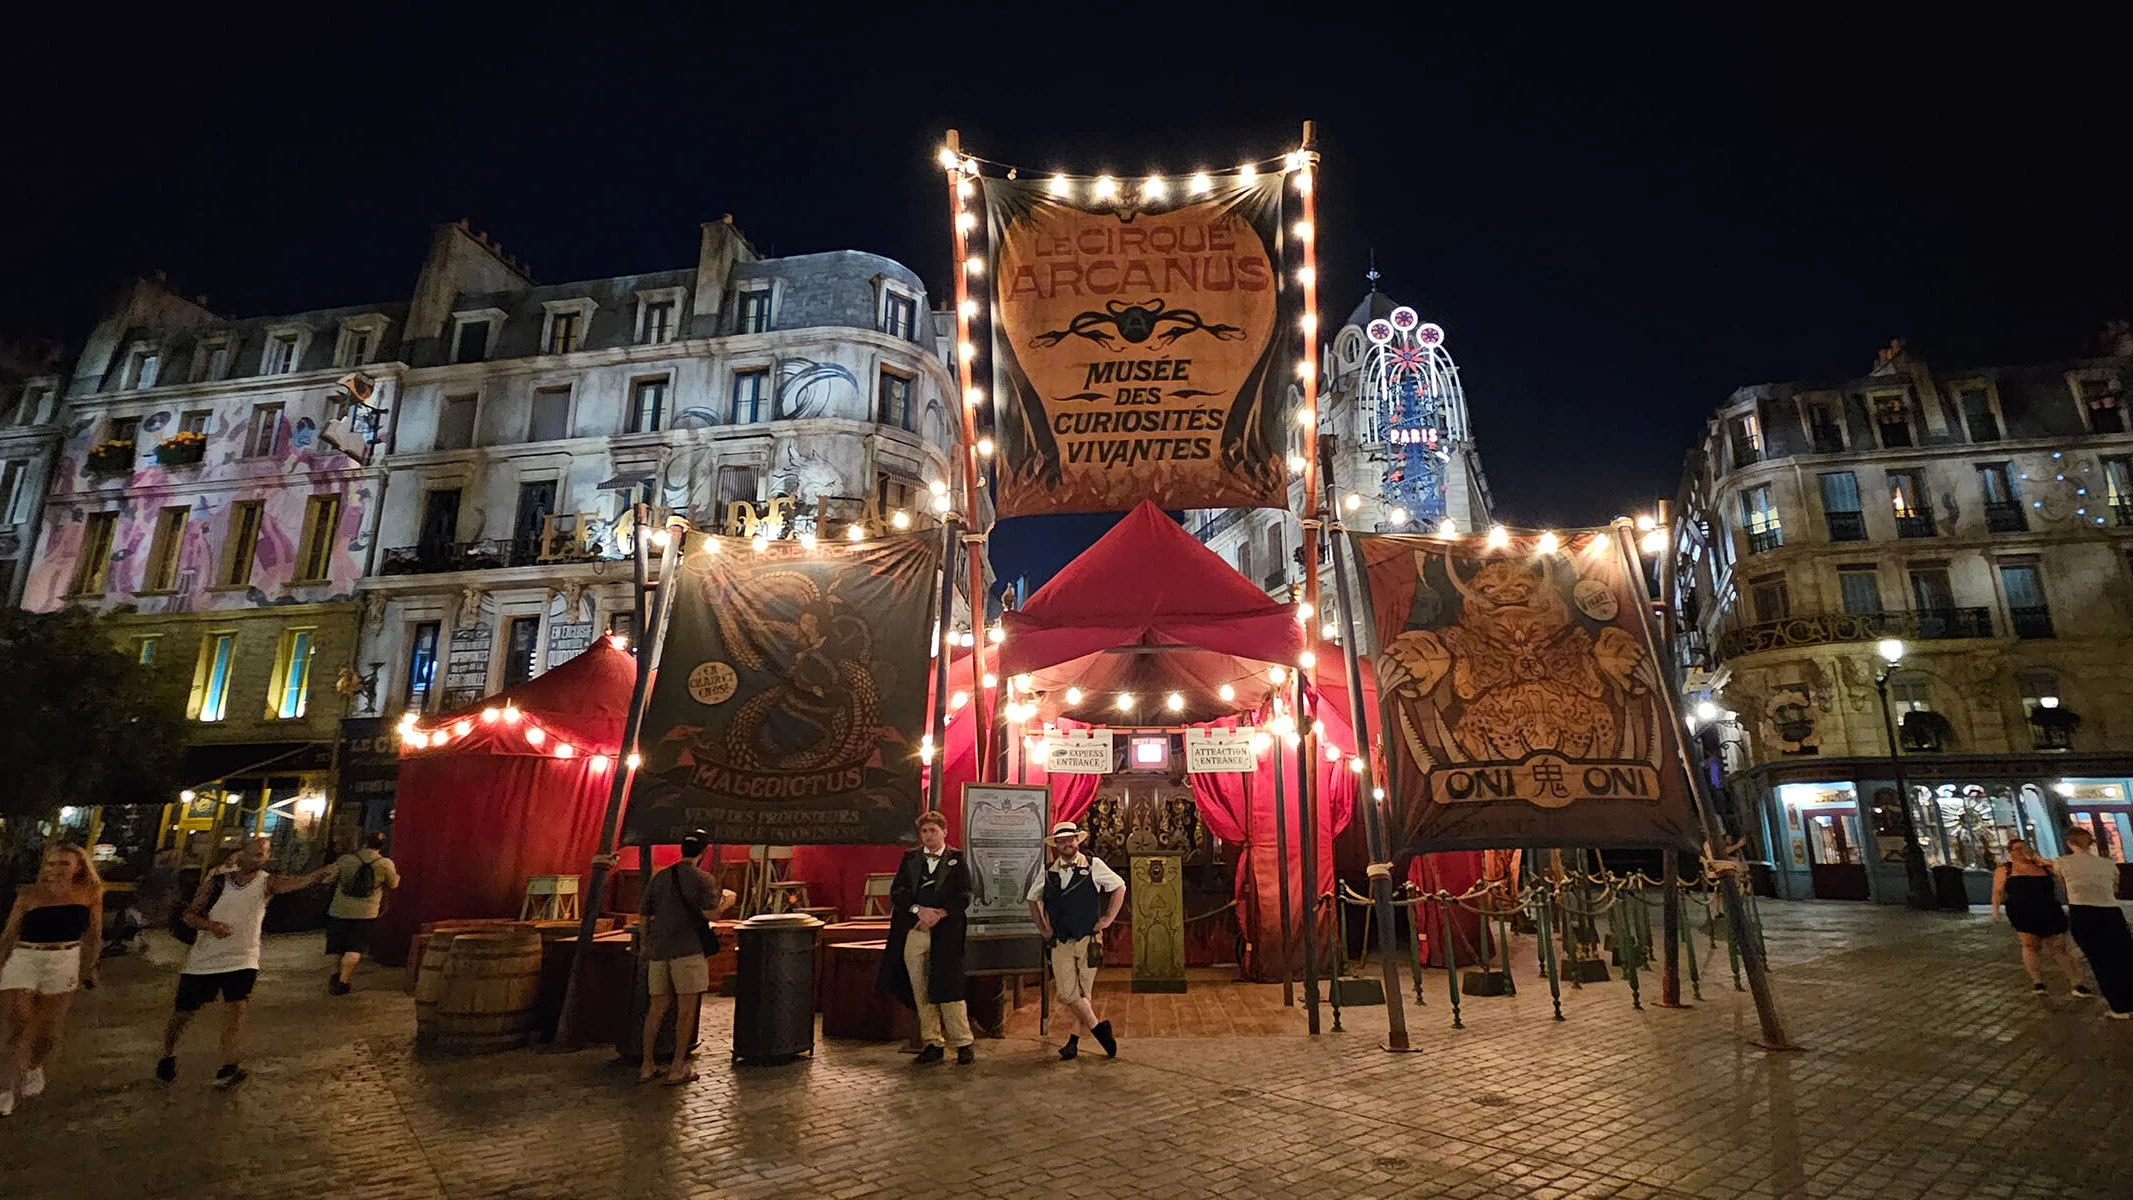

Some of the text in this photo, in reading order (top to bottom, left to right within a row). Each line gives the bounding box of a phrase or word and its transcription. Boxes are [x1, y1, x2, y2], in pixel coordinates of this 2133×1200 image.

[1034, 224, 1236, 257] LE CIRQUE
[1007, 255, 1271, 302] ARCANUS
[1082, 353, 1194, 391] MUSÉE
[1114, 387, 1162, 406] DES
[1053, 403, 1225, 435] CURIOSITÉS
[1390, 428, 1438, 444] PARIS
[1067, 438, 1213, 470] VIVANTES
[1056, 757, 1101, 767] ENTRANCE
[1069, 749, 1104, 758] EXPRESS
[1195, 747, 1248, 756] ATTRACTION
[1200, 755, 1244, 765] ENTRANCE
[693, 764, 863, 799] MALEDICTUS
[1446, 758, 1648, 799] ONI 鬼 ONI
